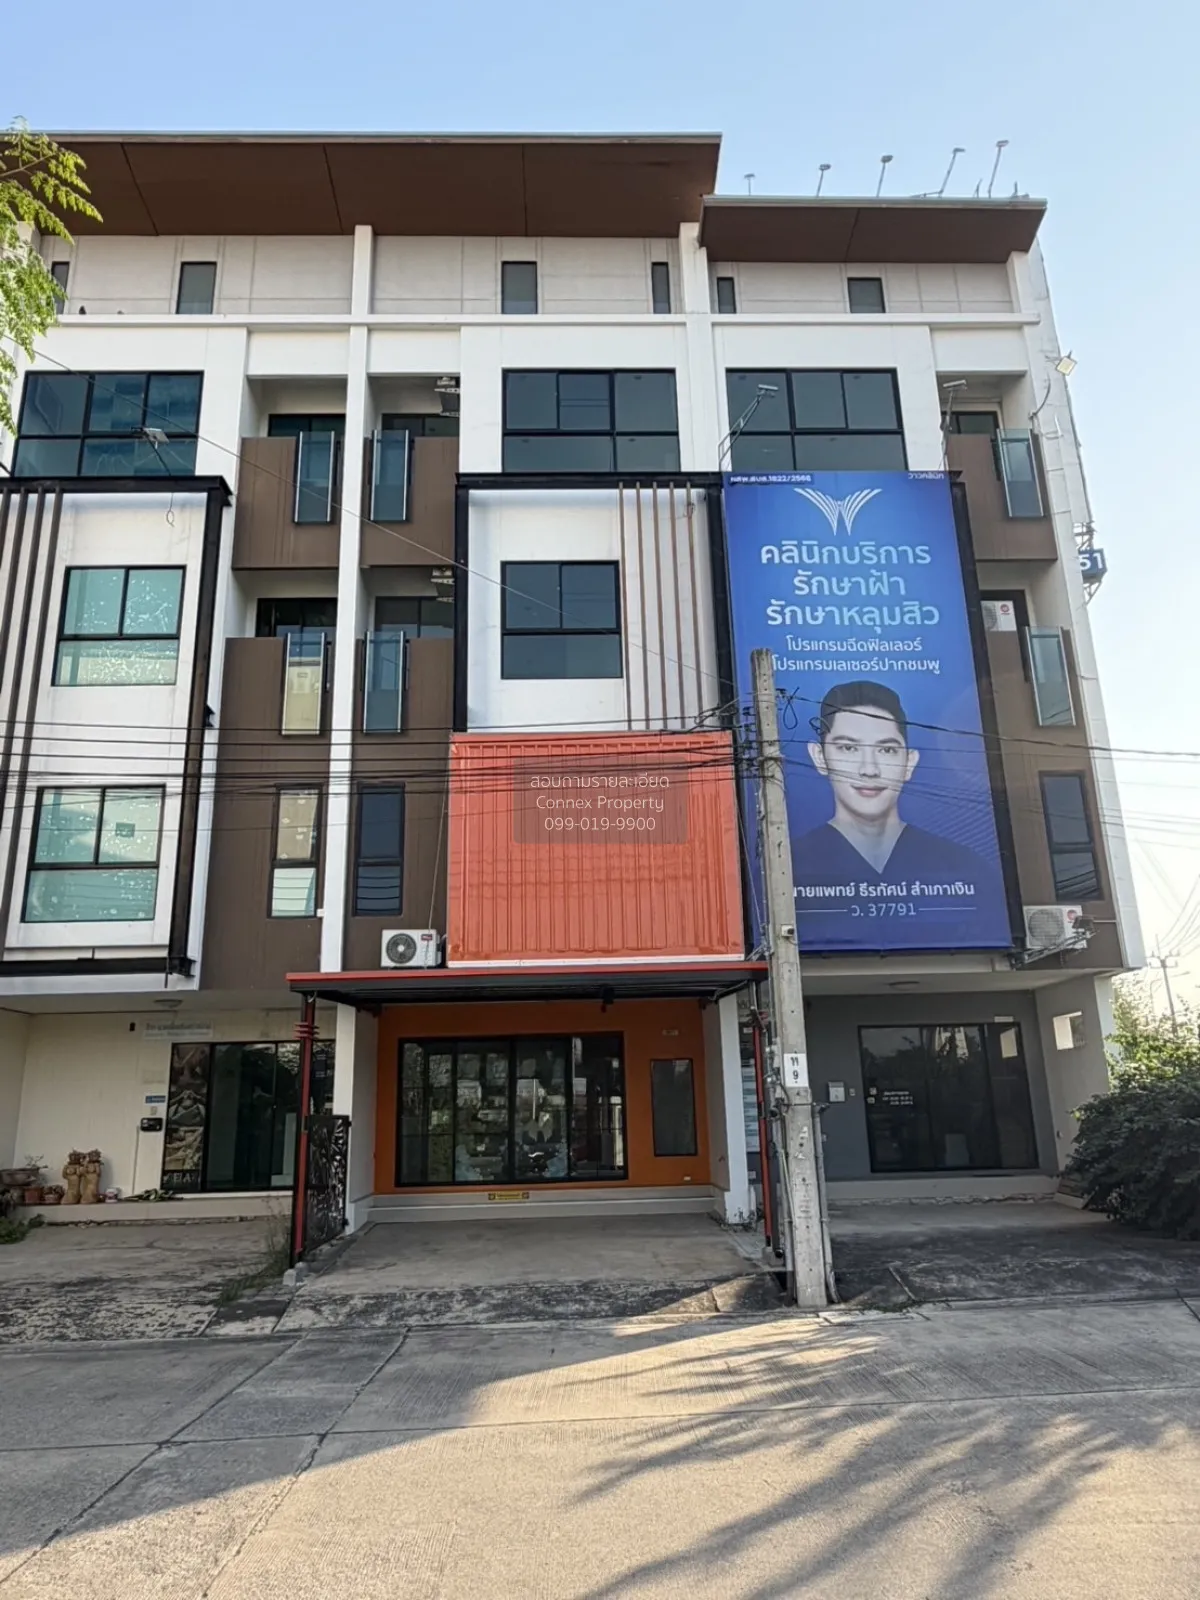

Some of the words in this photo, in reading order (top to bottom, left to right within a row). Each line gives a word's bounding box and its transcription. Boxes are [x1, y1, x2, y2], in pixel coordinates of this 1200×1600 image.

[761, 540, 932, 564] คลินิกบริการ
[793, 569, 906, 595] รักษาฝ้า
[766, 599, 940, 634] รักษาหลุมสิว
[786, 635, 922, 652] โปรแกรมฉีดฟิลเลอร์
[771, 654, 940, 674] โปรแกรมเลเซอร์ปากชมพู
[859, 882, 907, 896] ธีรทัศน์
[911, 880, 975, 896] สำเภาเงิน
[851, 904, 864, 917] ว.
[868, 902, 916, 917] 37791
